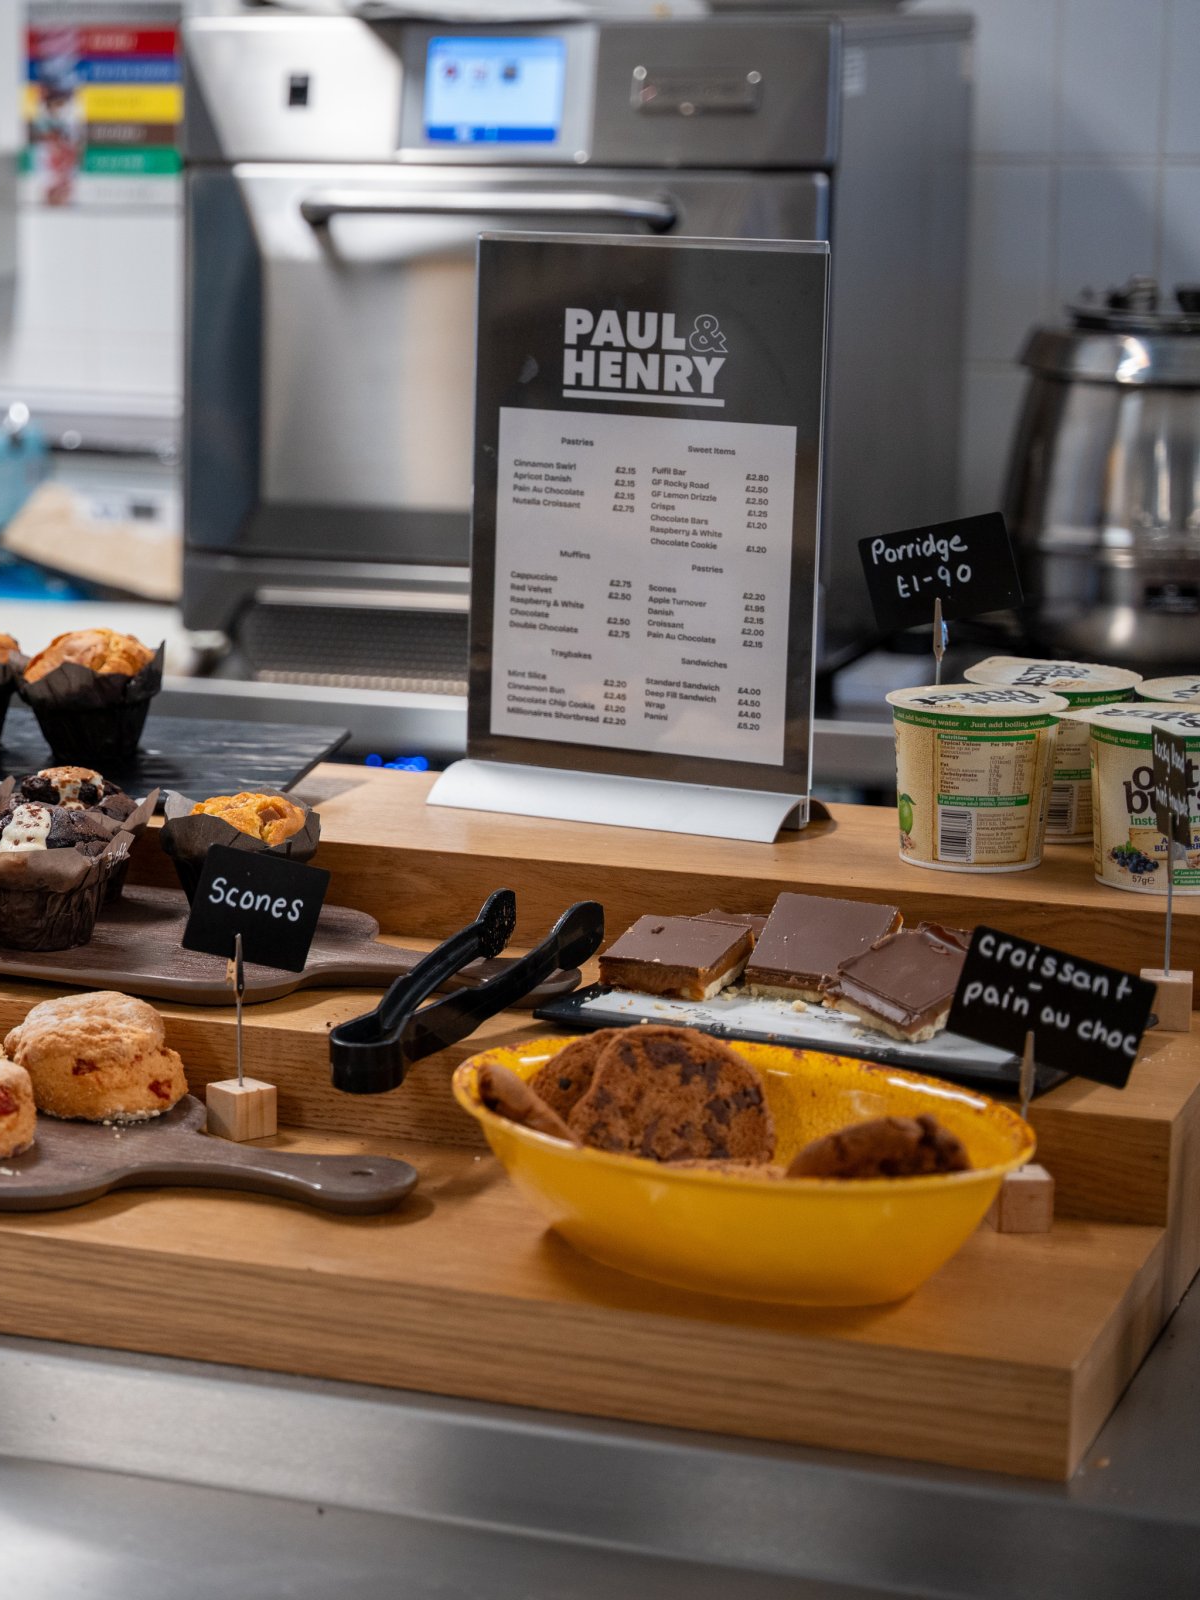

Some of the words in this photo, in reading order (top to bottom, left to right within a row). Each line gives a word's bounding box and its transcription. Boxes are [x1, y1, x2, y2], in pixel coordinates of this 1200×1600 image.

[564, 308, 686, 350] PAUL
[689, 314, 728, 352] &
[563, 349, 726, 394] HENRY
[561, 437, 594, 446] Pastries
[688, 446, 712, 454] Sweet
[714, 447, 736, 456] Items
[514, 459, 554, 469] Cinnamon
[556, 462, 576, 470] Swirl
[615, 466, 636, 474] £2.15
[514, 472, 542, 481] Apricot
[544, 474, 572, 482] Danish
[614, 480, 635, 488] £2.15
[664, 480, 688, 489] Rocky
[689, 482, 709, 490] Road
[513, 484, 530, 492] Pain
[544, 486, 584, 496] Chocolate
[745, 486, 768, 494] £2.50
[614, 492, 635, 500] £2.15
[664, 492, 688, 500] Lemon
[690, 494, 717, 502] Drizzle
[513, 497, 540, 506] Nutella
[542, 499, 580, 508] Croissant
[651, 502, 675, 511] Crisps
[745, 498, 768, 506] £2.50
[612, 504, 634, 513] £2.75
[748, 510, 768, 518] £1.25
[650, 514, 688, 524] Chocolate
[690, 516, 708, 525] Bars
[746, 522, 767, 530] £1.20
[650, 526, 690, 536] Raspberry
[700, 530, 722, 538] White
[650, 538, 689, 548] Chocolate
[690, 540, 717, 550] Cookie
[871, 533, 968, 565] Porridge
[560, 550, 590, 560] Muffins
[746, 546, 766, 554] £1.20
[692, 564, 723, 574] Pastries
[510, 570, 558, 582] Cappuccino
[510, 583, 525, 591] Red
[528, 585, 552, 594] Velvet
[609, 580, 632, 588] £2.75
[648, 584, 676, 593] Scones
[608, 592, 632, 600] £2.50
[742, 592, 765, 600] £2.20
[510, 596, 551, 608] Raspberry
[561, 600, 584, 609] White
[648, 596, 670, 604] Apple
[672, 598, 706, 608] Turnover
[510, 608, 549, 618] Chocolate
[648, 608, 674, 616] Danish
[607, 617, 630, 626] £2.50
[648, 620, 684, 629] Croissant
[744, 616, 764, 624] £2.15
[509, 620, 536, 630] Double
[539, 623, 578, 634] Chocolate
[741, 628, 764, 636] £2.00
[608, 630, 630, 638] £2.75
[678, 634, 716, 644] Chocolate
[742, 640, 762, 648] £2.15
[551, 649, 592, 660] Traybakes
[682, 658, 728, 668] Sandwiches
[508, 670, 526, 678] Mint
[528, 672, 546, 680] Slice
[507, 682, 548, 692] Cinnamon
[550, 686, 565, 694] Bun
[603, 680, 626, 688] £2.20
[646, 678, 680, 688] Standard
[682, 681, 720, 692] Sandwich
[645, 689, 664, 698] Deep
[680, 692, 716, 703] Sandwich
[738, 687, 760, 696] £4.00
[507, 694, 546, 704] Chocolate
[548, 698, 566, 708] Chip
[568, 700, 595, 710] Cookie
[644, 701, 665, 710] Wrap
[738, 699, 760, 707] £4.50
[604, 704, 625, 713] £1.20
[506, 706, 552, 718] Millionaires
[554, 711, 599, 723] Shortbread
[644, 712, 668, 720] Panini
[602, 716, 626, 726] £2.20
[737, 722, 760, 730] £5.20
[915, 716, 936, 726] boiling
[1004, 720, 1028, 729] boiling
[208, 877, 304, 922] Scones
[978, 934, 1132, 1000] croissant
[963, 982, 1030, 1016] pain
[1040, 1007, 1070, 1028] au
[1077, 1020, 1136, 1055] choc
